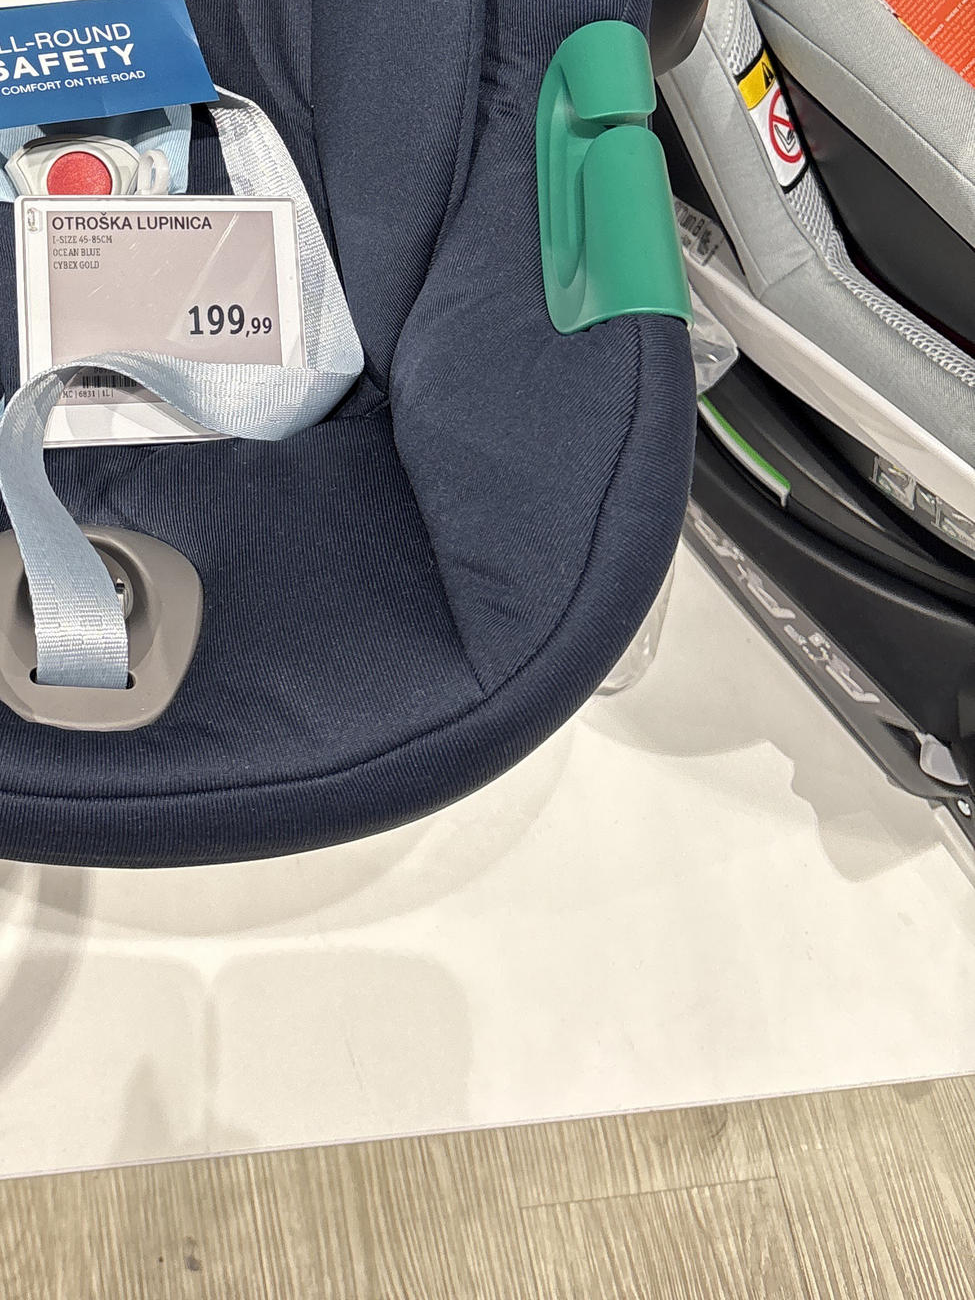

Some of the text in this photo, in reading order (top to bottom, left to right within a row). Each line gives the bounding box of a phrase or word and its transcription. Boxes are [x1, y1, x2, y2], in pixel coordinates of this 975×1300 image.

[1, 80, 61, 97] COMFORT
[64, 78, 84, 89] ON
[84, 75, 110, 86] THE
[112, 70, 146, 82] ROAD
[52, 212, 213, 230] OTROŠKA LUPINICA
[52, 235, 113, 244] I-SIZE 45-85CM
[53, 248, 101, 257] OCEAN BLUE
[53, 260, 100, 269] CYBEX GOLD
[188, 304, 272, 338] 199,99
